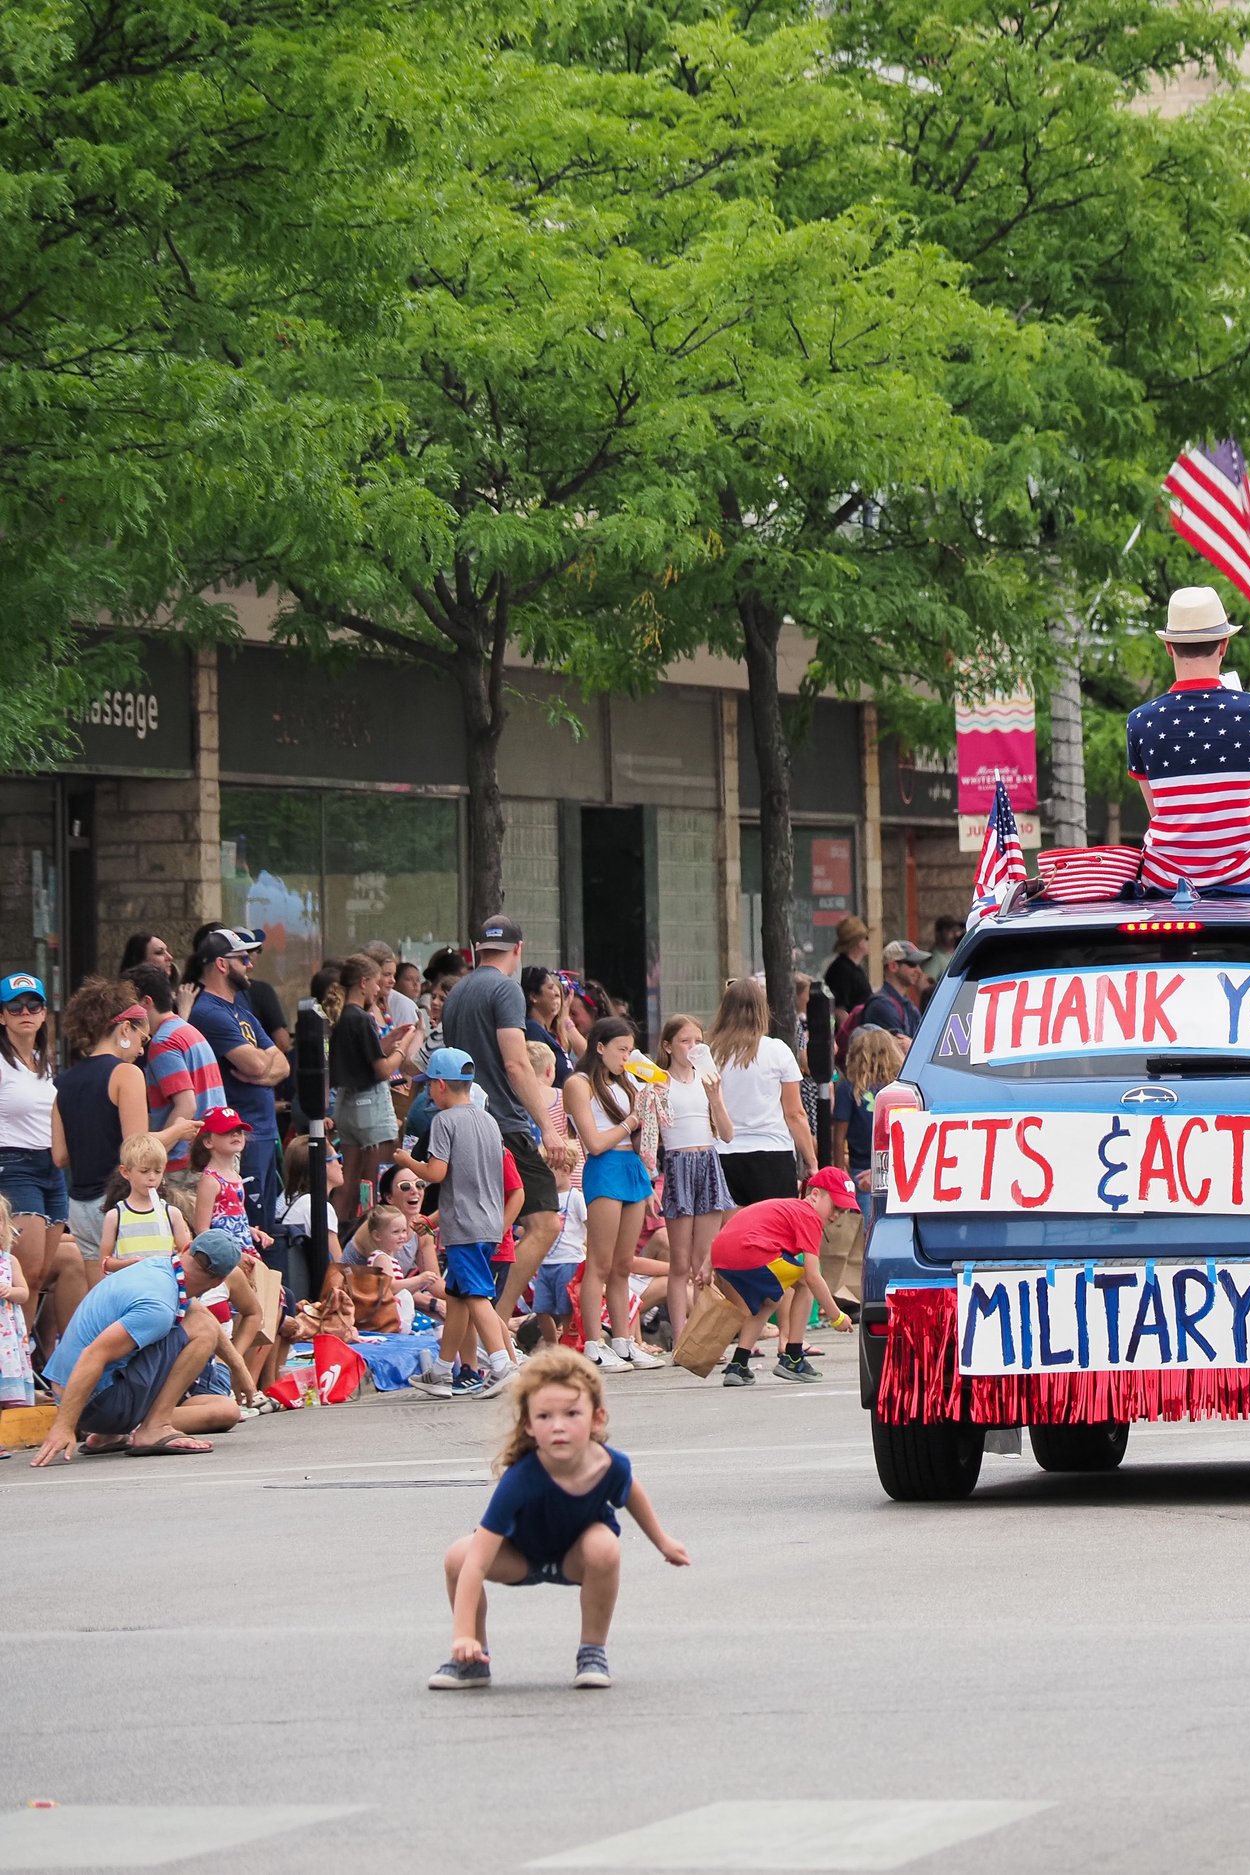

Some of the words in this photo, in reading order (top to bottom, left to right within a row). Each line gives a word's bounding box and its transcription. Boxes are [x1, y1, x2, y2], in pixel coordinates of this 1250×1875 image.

[81, 690, 158, 739] assage
[978, 971, 1186, 1054] THANK
[890, 1116, 1054, 1208] VETS
